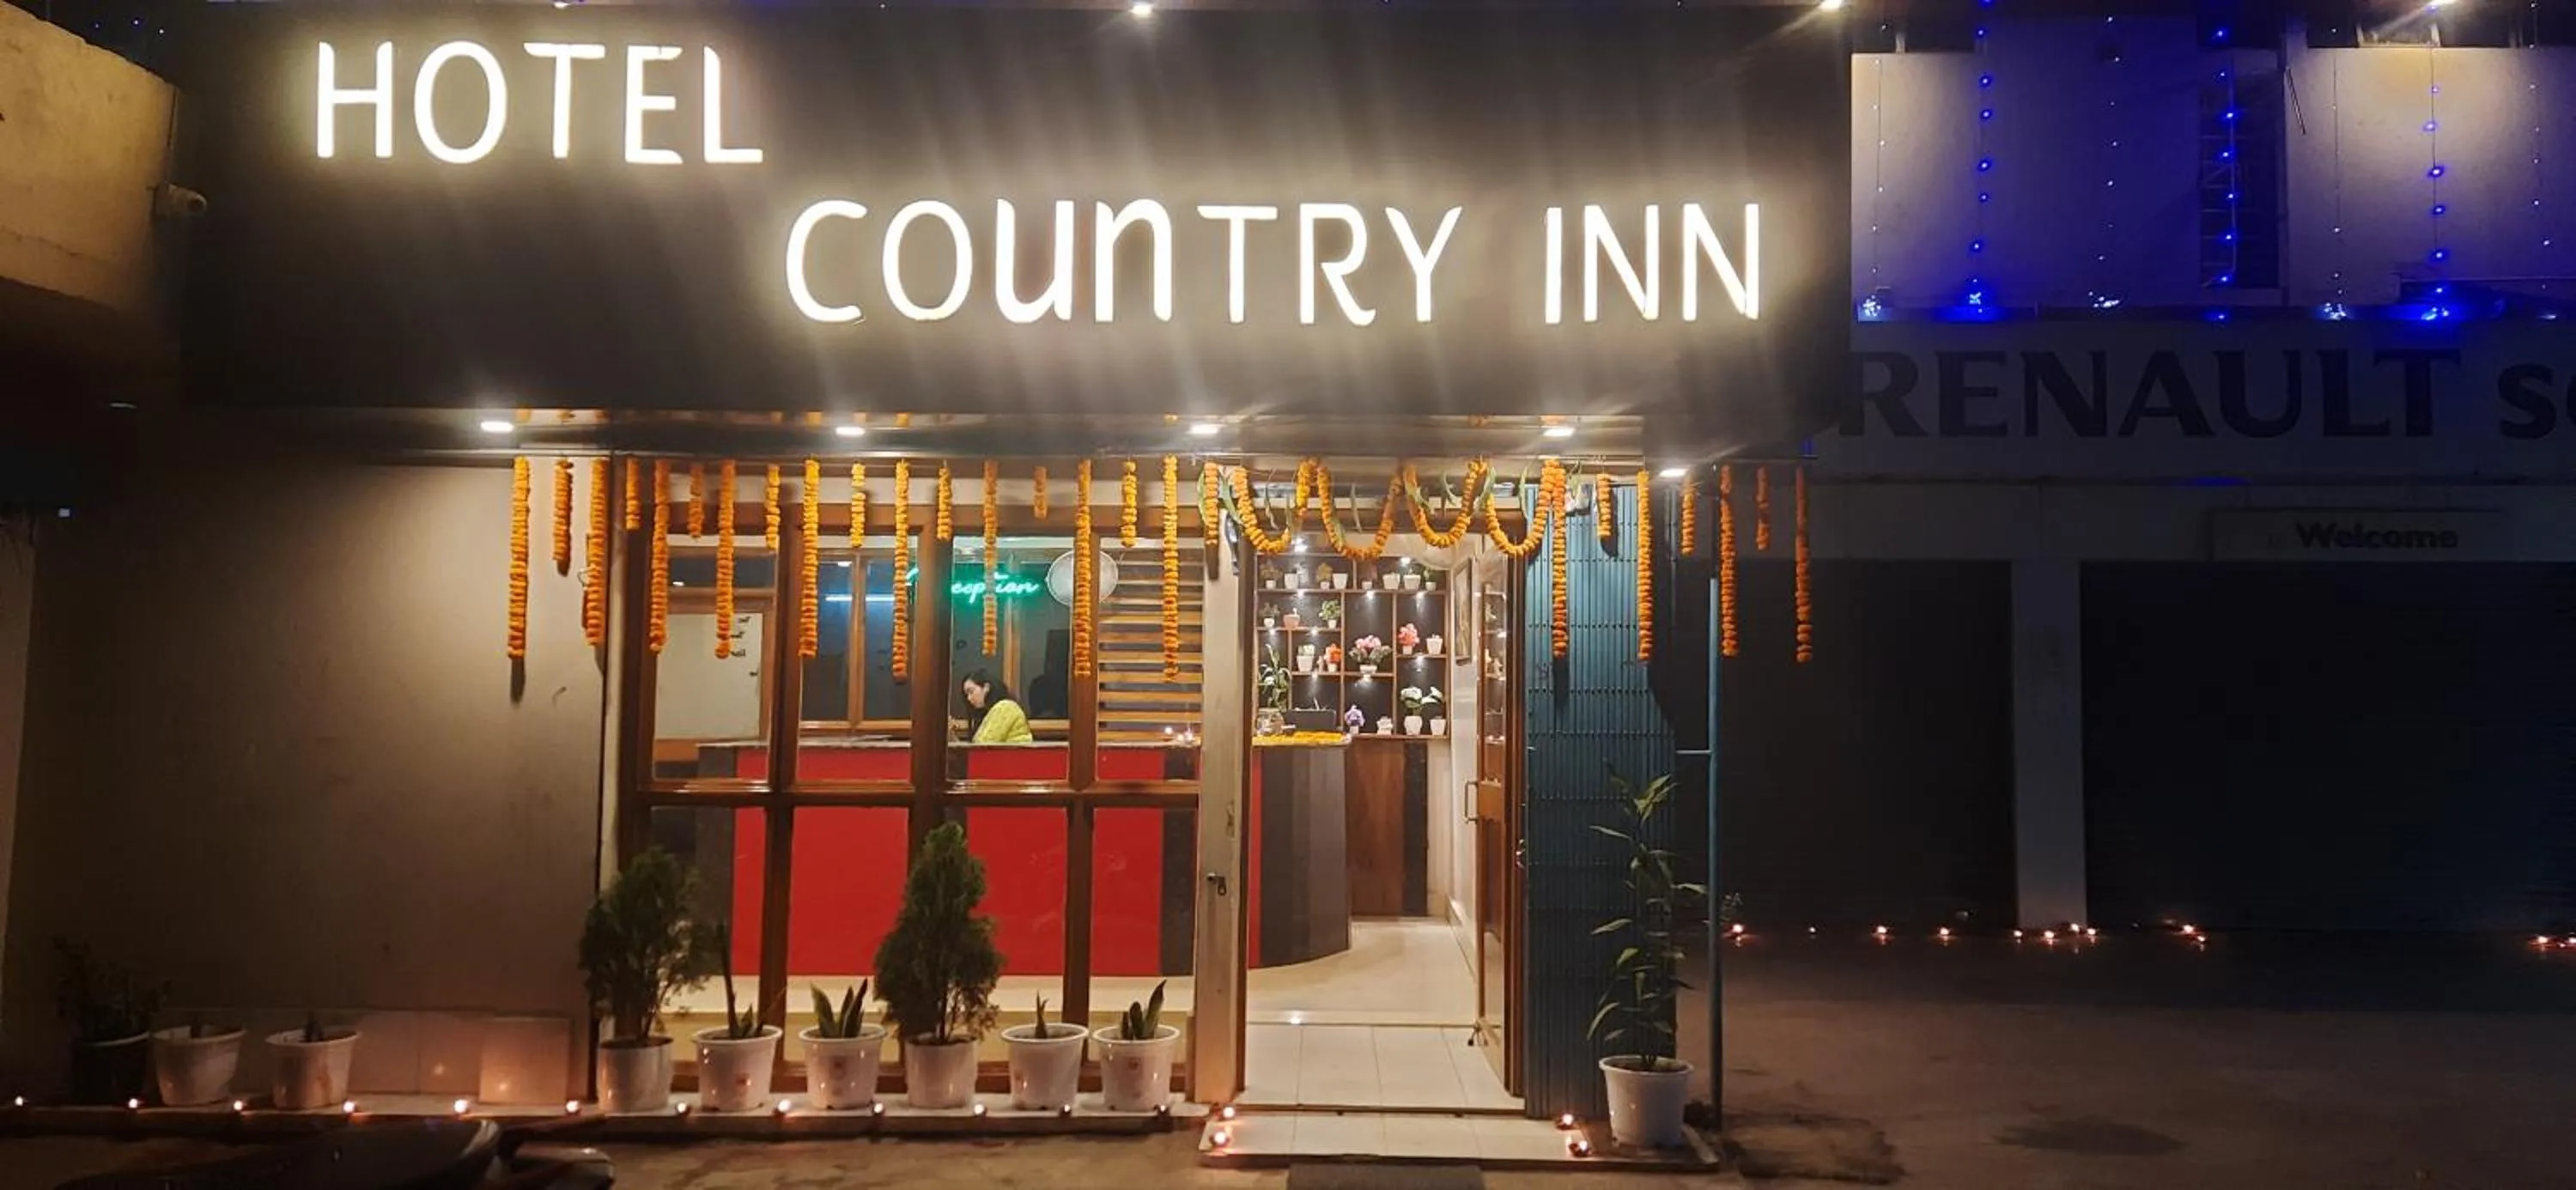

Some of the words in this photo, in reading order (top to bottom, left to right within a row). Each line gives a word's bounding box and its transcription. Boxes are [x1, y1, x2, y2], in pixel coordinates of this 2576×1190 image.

[316, 40, 763, 164] HOTEL
[1545, 203, 1759, 325] INN
[1838, 349, 2461, 439] RENAULT
[2498, 363, 2576, 440] S
[2295, 521, 2458, 549] Welcome
